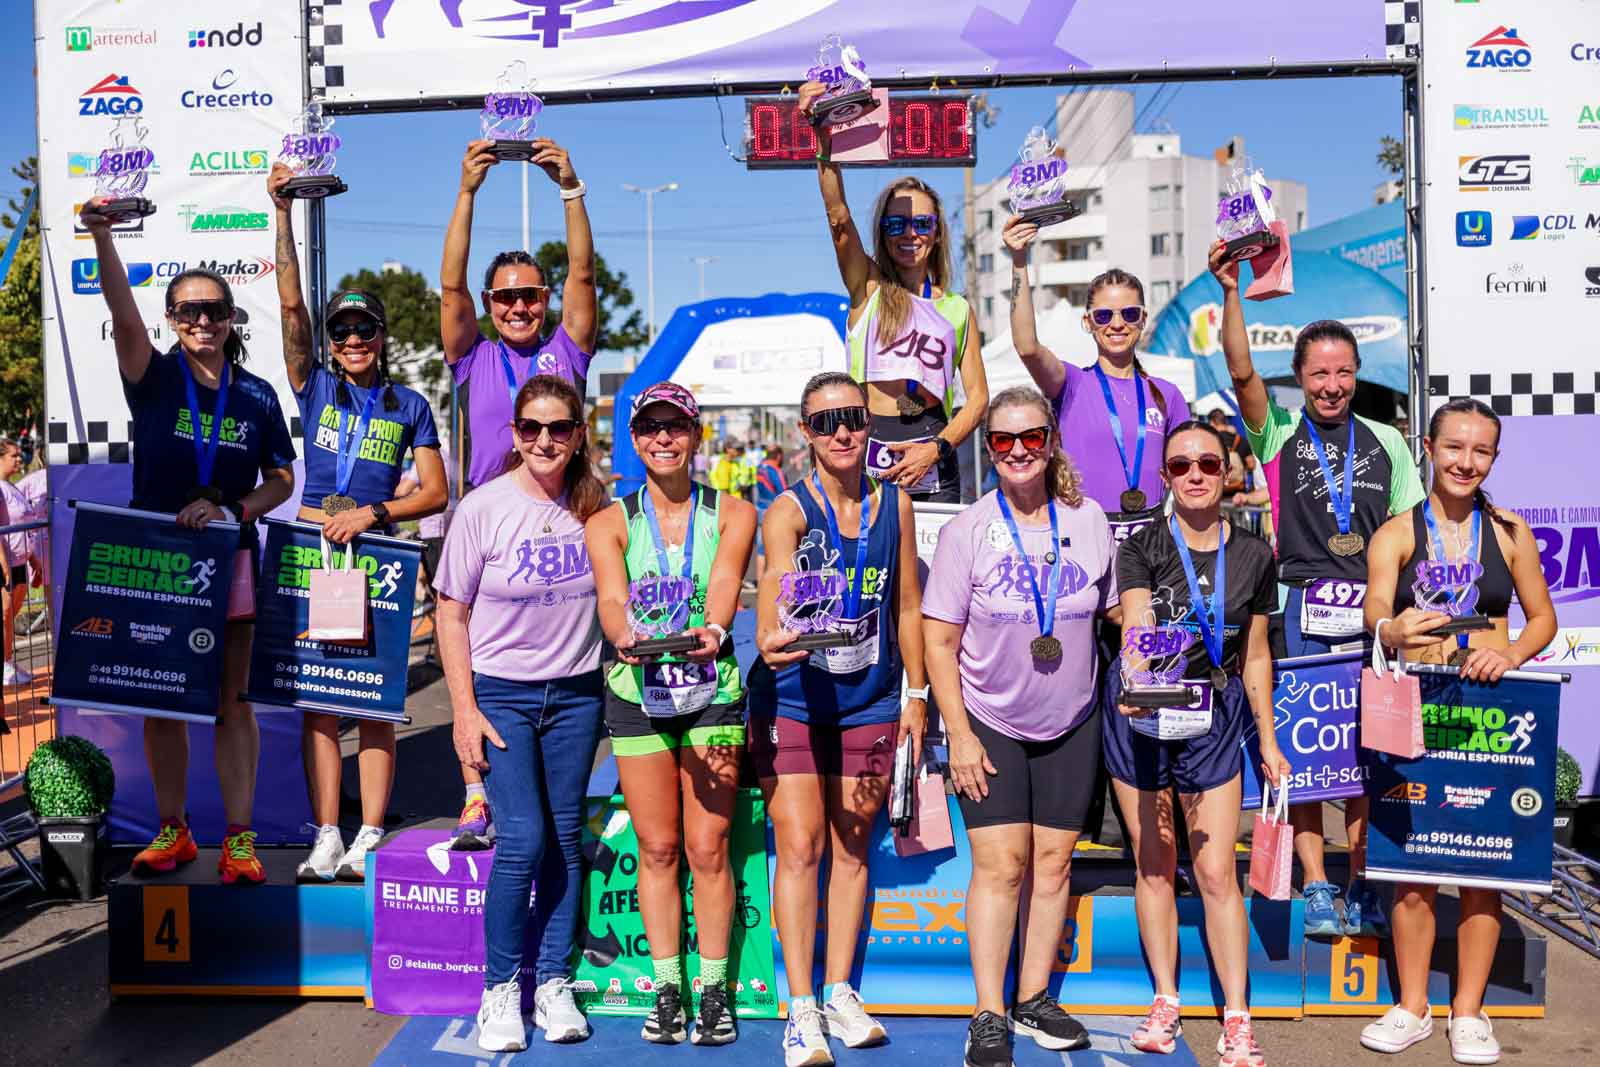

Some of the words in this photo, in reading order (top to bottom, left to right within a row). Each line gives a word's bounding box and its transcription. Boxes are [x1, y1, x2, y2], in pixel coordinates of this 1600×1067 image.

[207, 22, 262, 47] ndd
[1466, 49, 1532, 68] ZAGO
[79, 96, 143, 116] ZAGO
[181, 90, 273, 108] Crecerto
[1472, 107, 1549, 123] TRANSUL
[110, 150, 145, 173] 8M
[190, 152, 242, 170] ACIL
[191, 213, 269, 230] AMURES
[1543, 215, 1576, 230] CDL
[200, 259, 259, 276] Marka
[1486, 273, 1546, 294] femini
[1561, 508, 1566, 523] E
[89, 542, 191, 573] BRUNO
[85, 584, 152, 600] ASSESSORIA
[153, 593, 213, 607] ESPORTIVA
[1316, 582, 1367, 606] 497
[294, 640, 318, 649] BIKE
[327, 645, 369, 656] FITNESS
[113, 665, 186, 683] 99146.0696
[286, 665, 299, 674] 49
[302, 663, 384, 686] 99146.0696
[1309, 679, 1361, 712] Clu
[1292, 717, 1356, 754] Cor
[1468, 753, 1535, 766] ESPORTIVA
[1444, 785, 1491, 799] Breaking
[1416, 833, 1428, 842] 49
[1430, 832, 1512, 849] 99146.0696
[382, 882, 458, 905] ELAINE
[383, 900, 458, 914] TREINAMENTO
[463, 907, 483, 915] PER
[154, 908, 180, 953] 4
[1058, 918, 1080, 965] 3
[1343, 952, 1365, 997] 5
